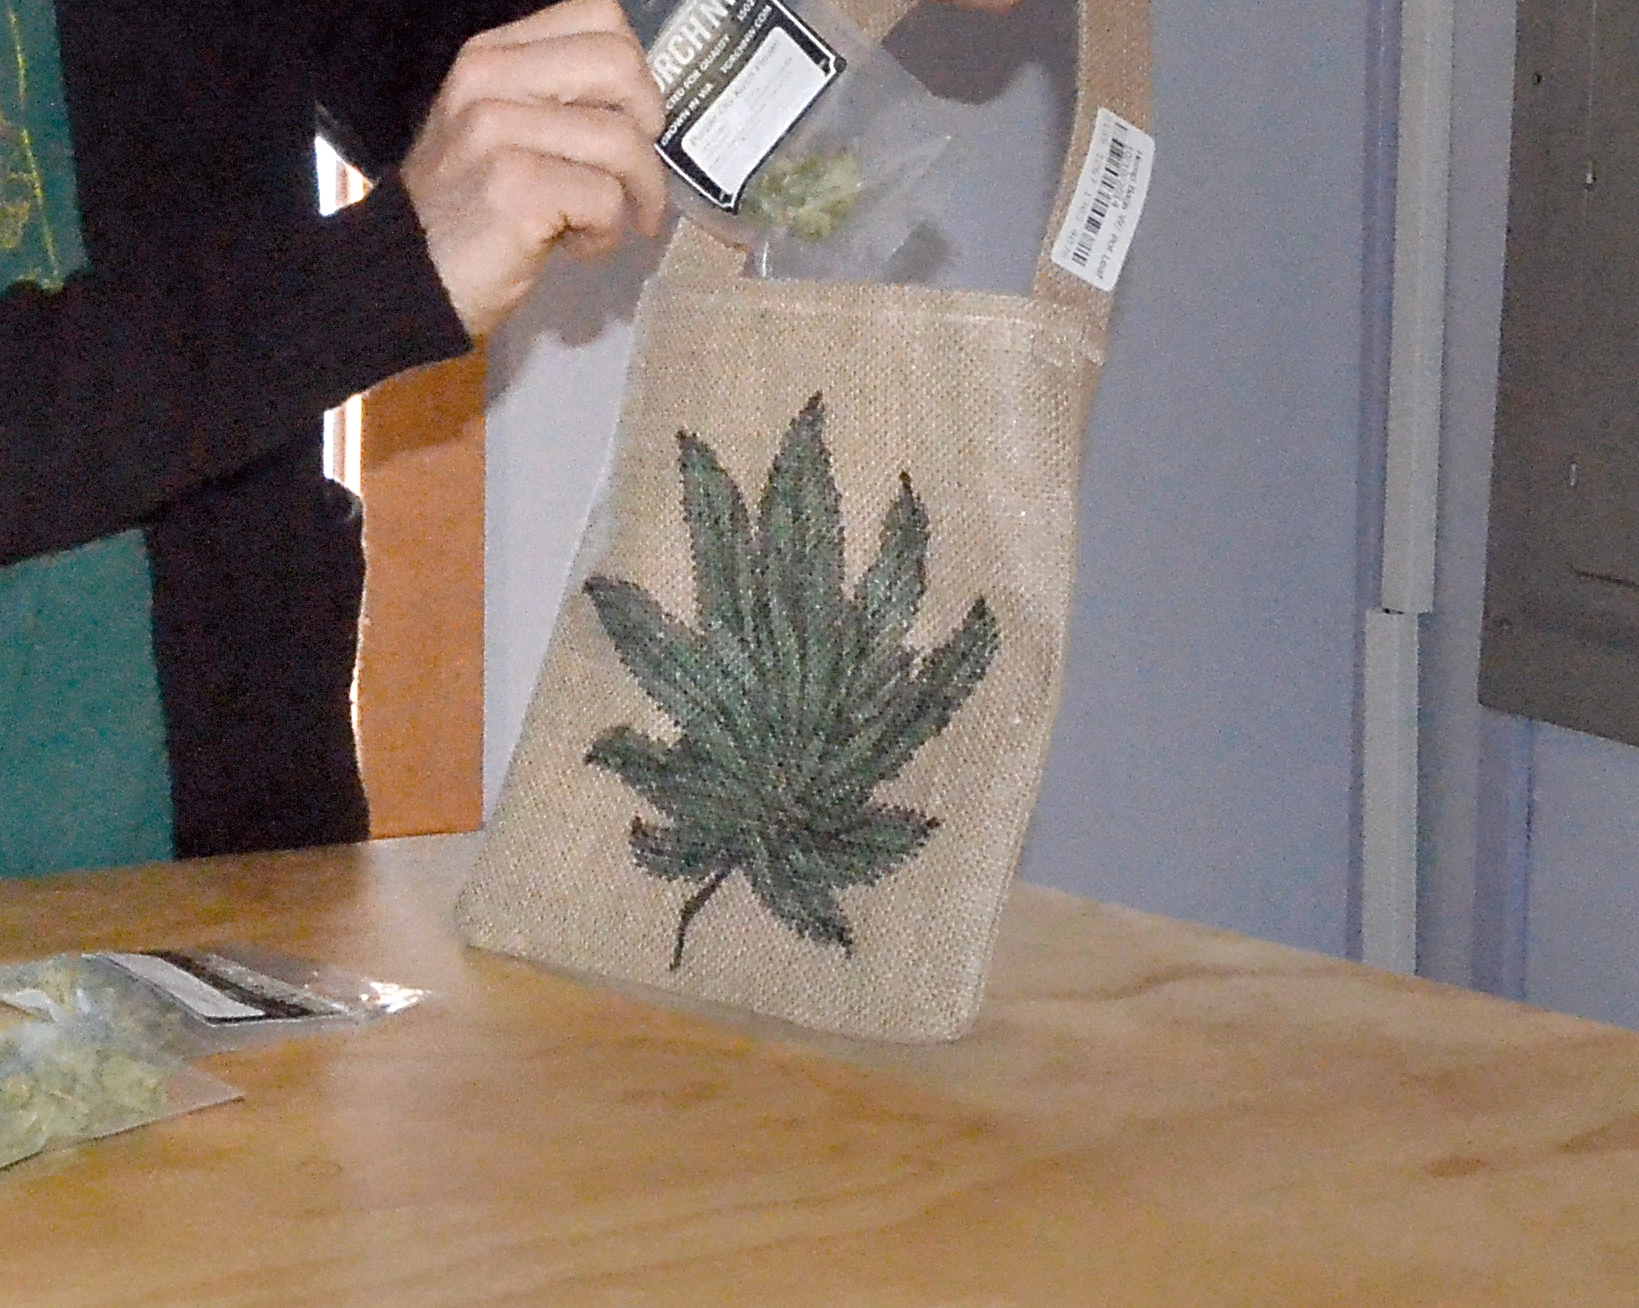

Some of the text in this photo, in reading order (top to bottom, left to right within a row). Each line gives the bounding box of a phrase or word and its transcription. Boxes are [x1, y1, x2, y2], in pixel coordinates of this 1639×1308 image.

[665, 87, 685, 112] CTED
[683, 69, 701, 89] FOR
[699, 33, 731, 71] QUALITY
[659, 109, 691, 146] GROWN
[688, 98, 700, 110] IN
[1095, 255, 1110, 279] Leaf
